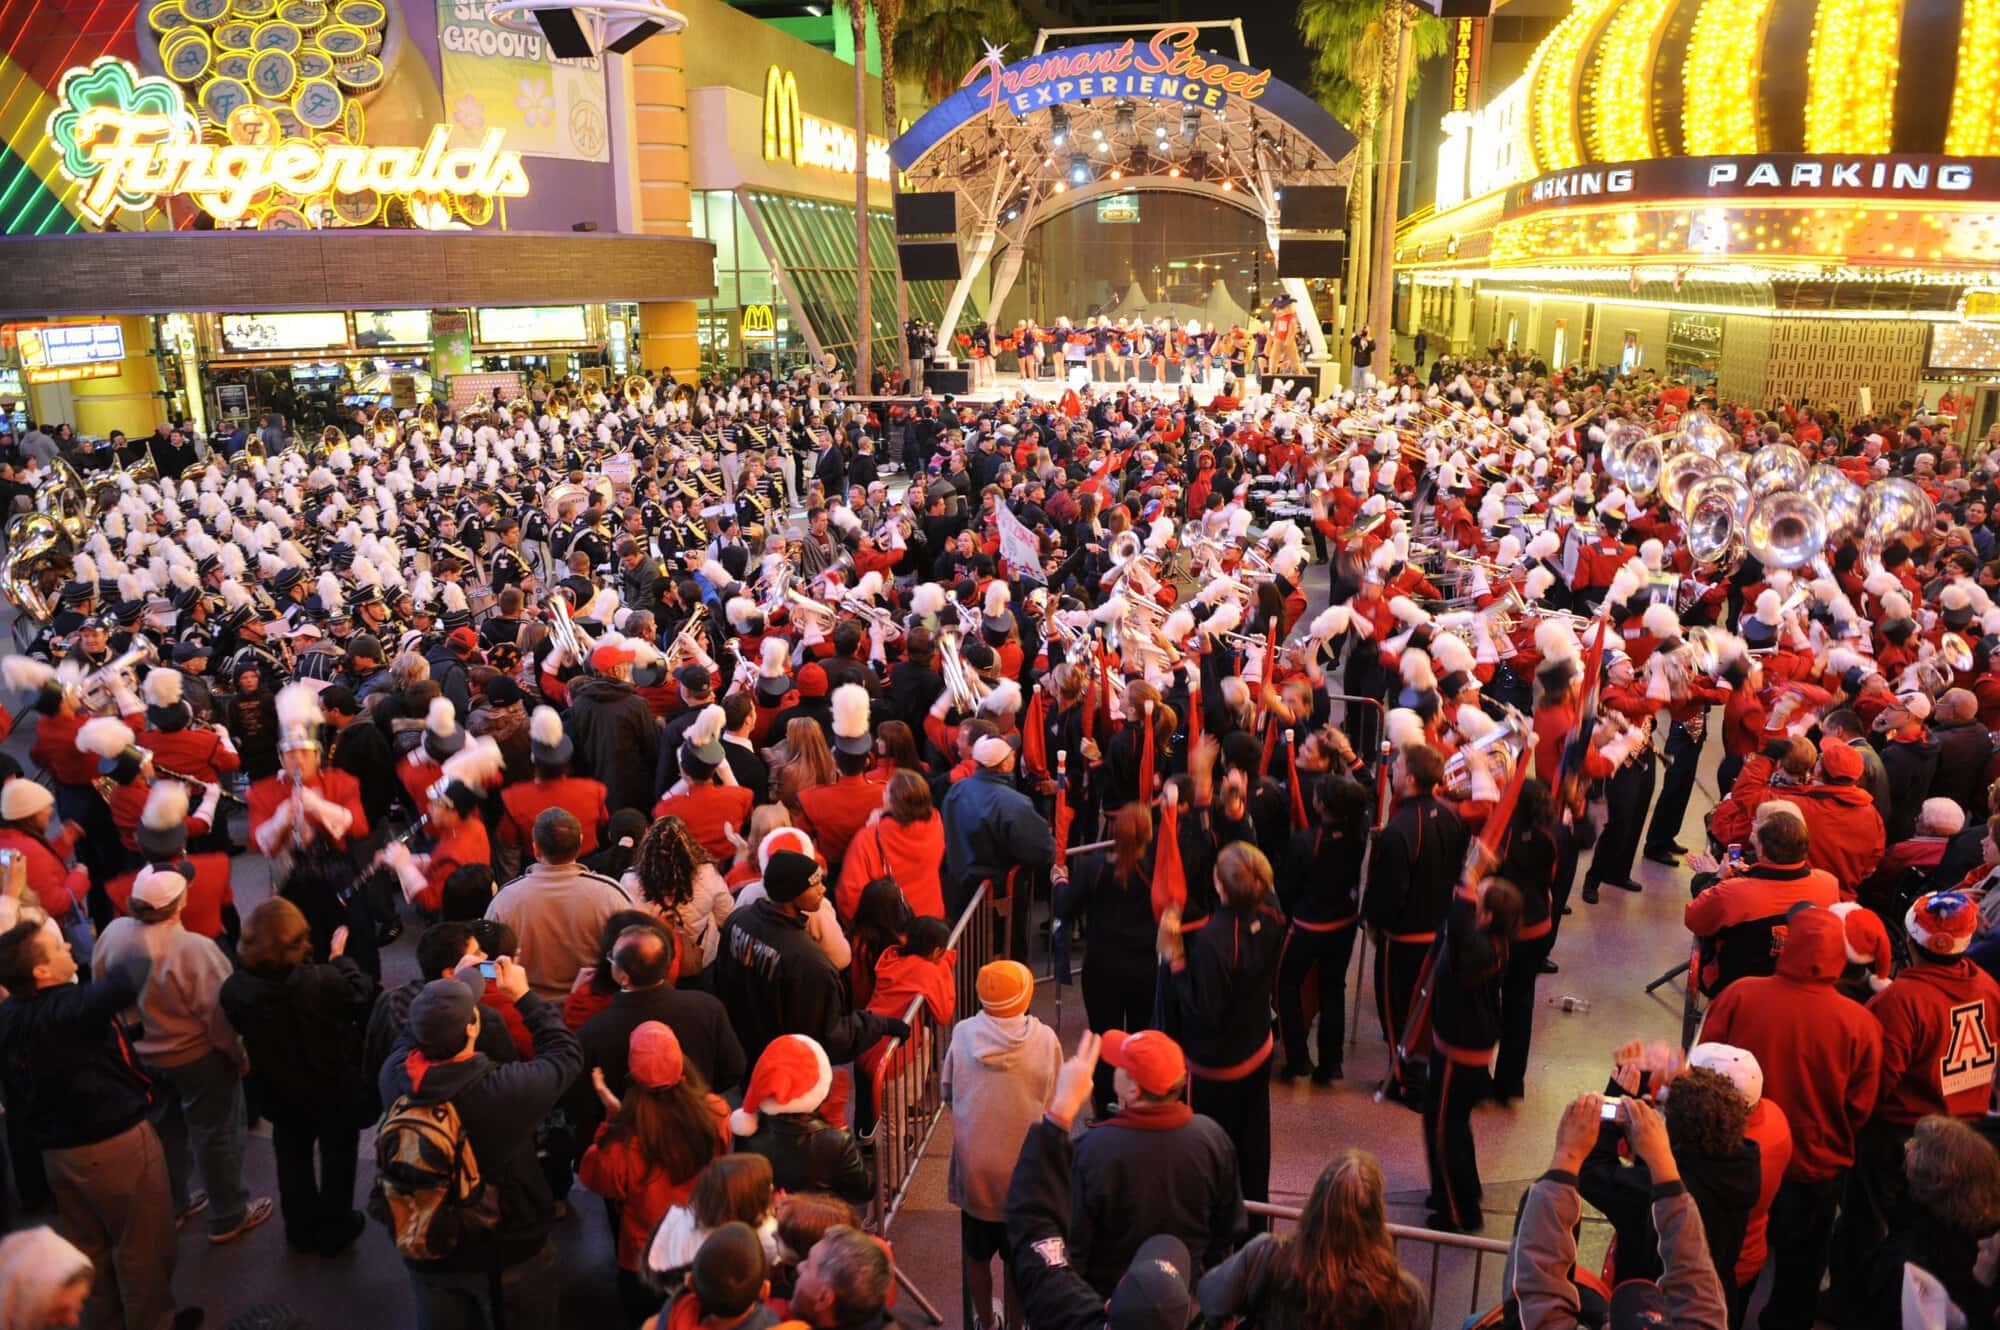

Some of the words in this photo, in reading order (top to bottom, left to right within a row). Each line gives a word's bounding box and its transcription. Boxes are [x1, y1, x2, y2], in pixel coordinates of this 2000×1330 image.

[443, 26, 542, 60] GROOVY
[960, 38, 1135, 119] Fremont
[1134, 25, 1272, 99] Street
[1453, 16, 1473, 111] NTRANCE
[1015, 75, 1226, 110] EXPERIENCE
[1517, 168, 1634, 204] ARKING
[1708, 162, 1973, 191] PARKING
[1941, 1000, 1997, 1078] A
